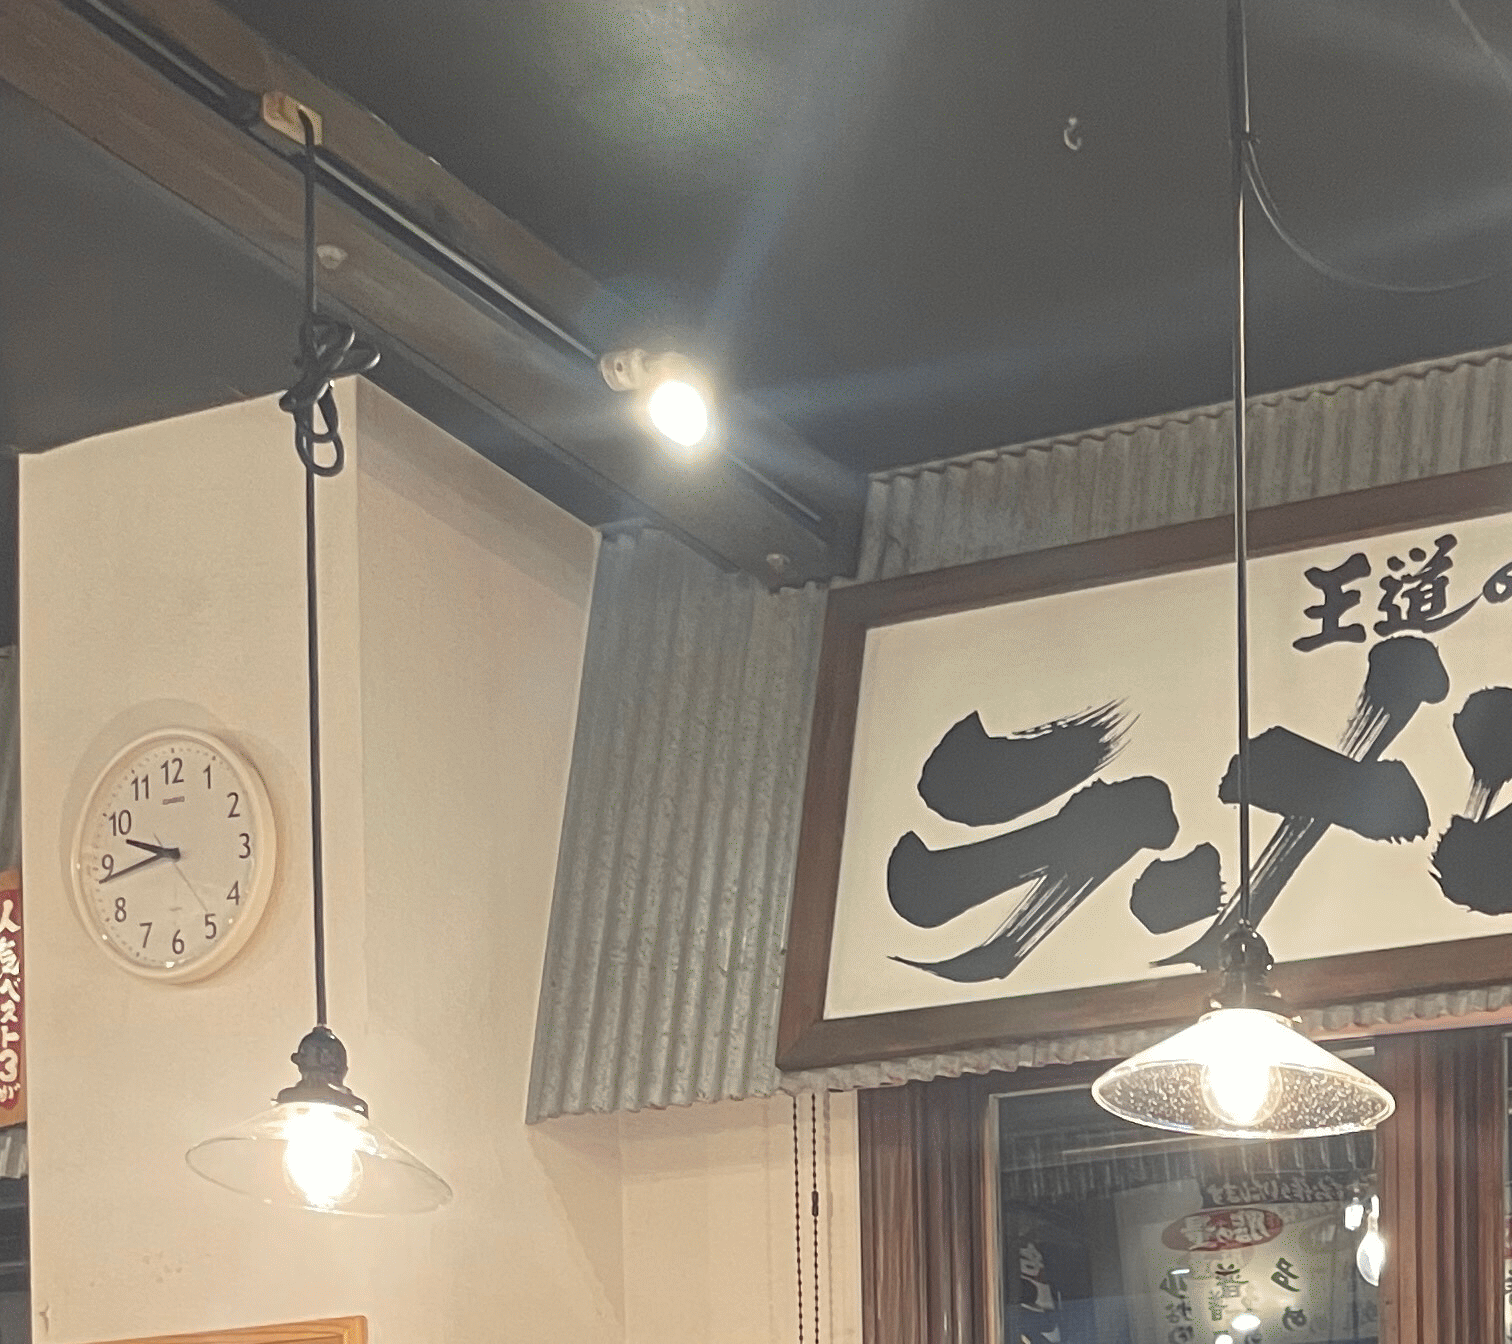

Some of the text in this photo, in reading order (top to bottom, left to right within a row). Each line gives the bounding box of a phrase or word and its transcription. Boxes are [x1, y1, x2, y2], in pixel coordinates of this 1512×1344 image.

[161, 758, 185, 785] 12
[203, 764, 211, 789] 1
[131, 774, 149, 801] 11
[227, 792, 241, 818] 2
[109, 810, 132, 836] 10
[239, 833, 251, 859] 3
[101, 854, 114, 880] 9
[227, 881, 240, 905] 4
[115, 897, 127, 922] 8
[139, 922, 153, 948] 7
[205, 914, 217, 939] 5
[172, 929, 185, 954] 6
